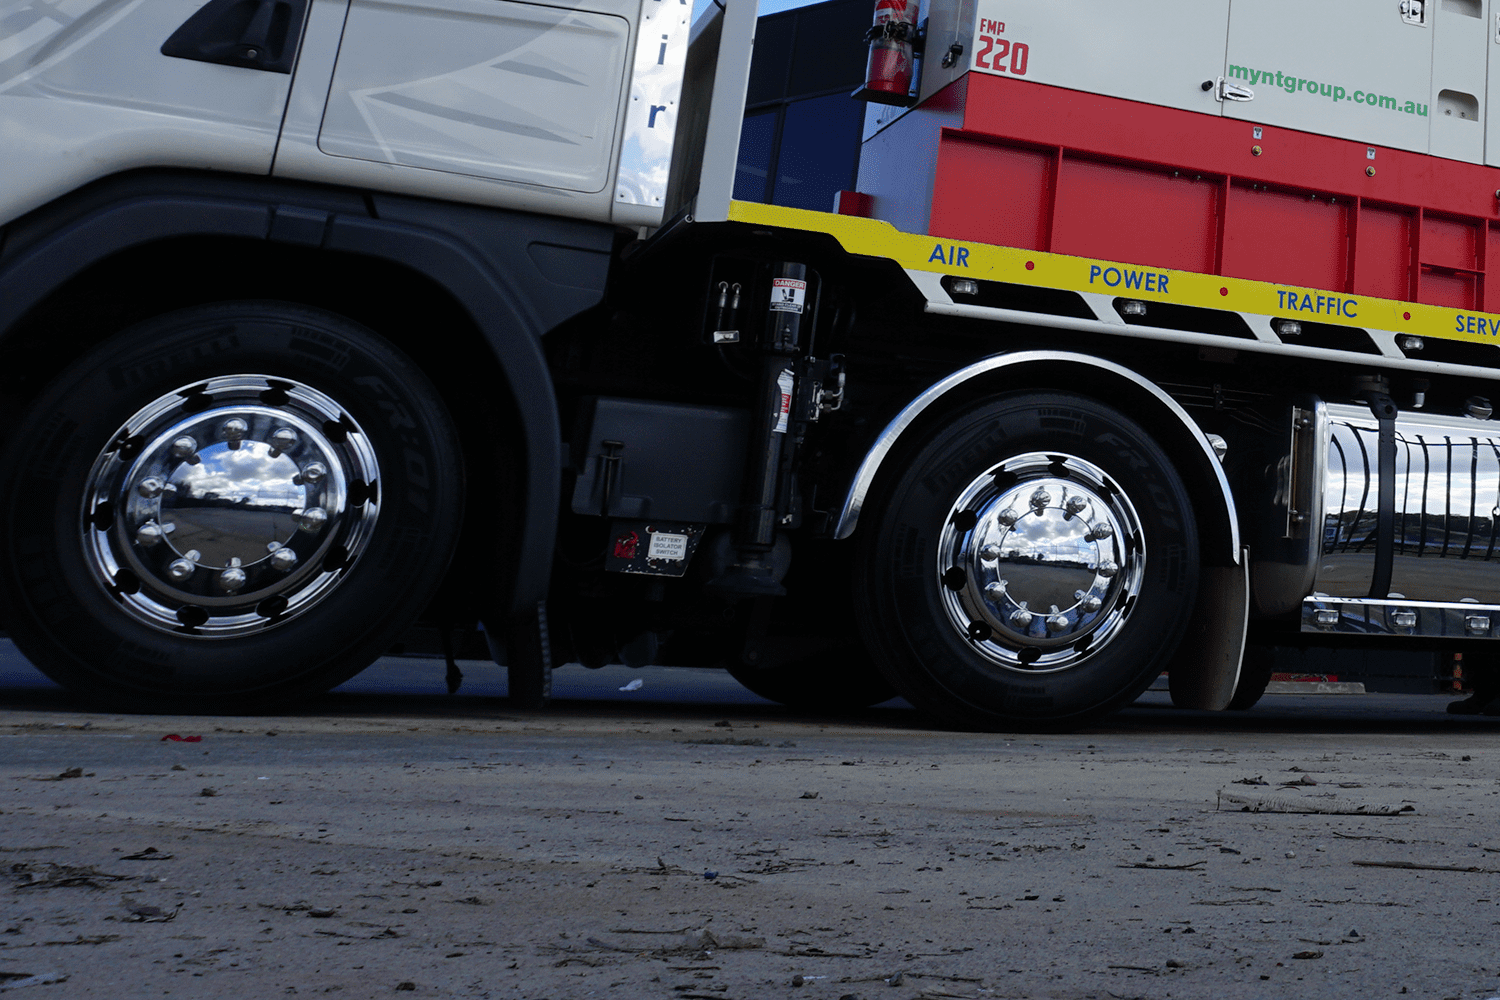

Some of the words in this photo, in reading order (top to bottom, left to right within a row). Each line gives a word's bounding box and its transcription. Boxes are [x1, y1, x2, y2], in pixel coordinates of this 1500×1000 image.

[979, 18, 1006, 36] FMP
[975, 35, 1030, 76] 220
[1228, 63, 1429, 118] myntgroup.com.au
[928, 243, 970, 269] AIR
[775, 280, 804, 289] DANGER
[1089, 265, 1170, 294] POWER
[1276, 290, 1359, 319] TRAFFIC
